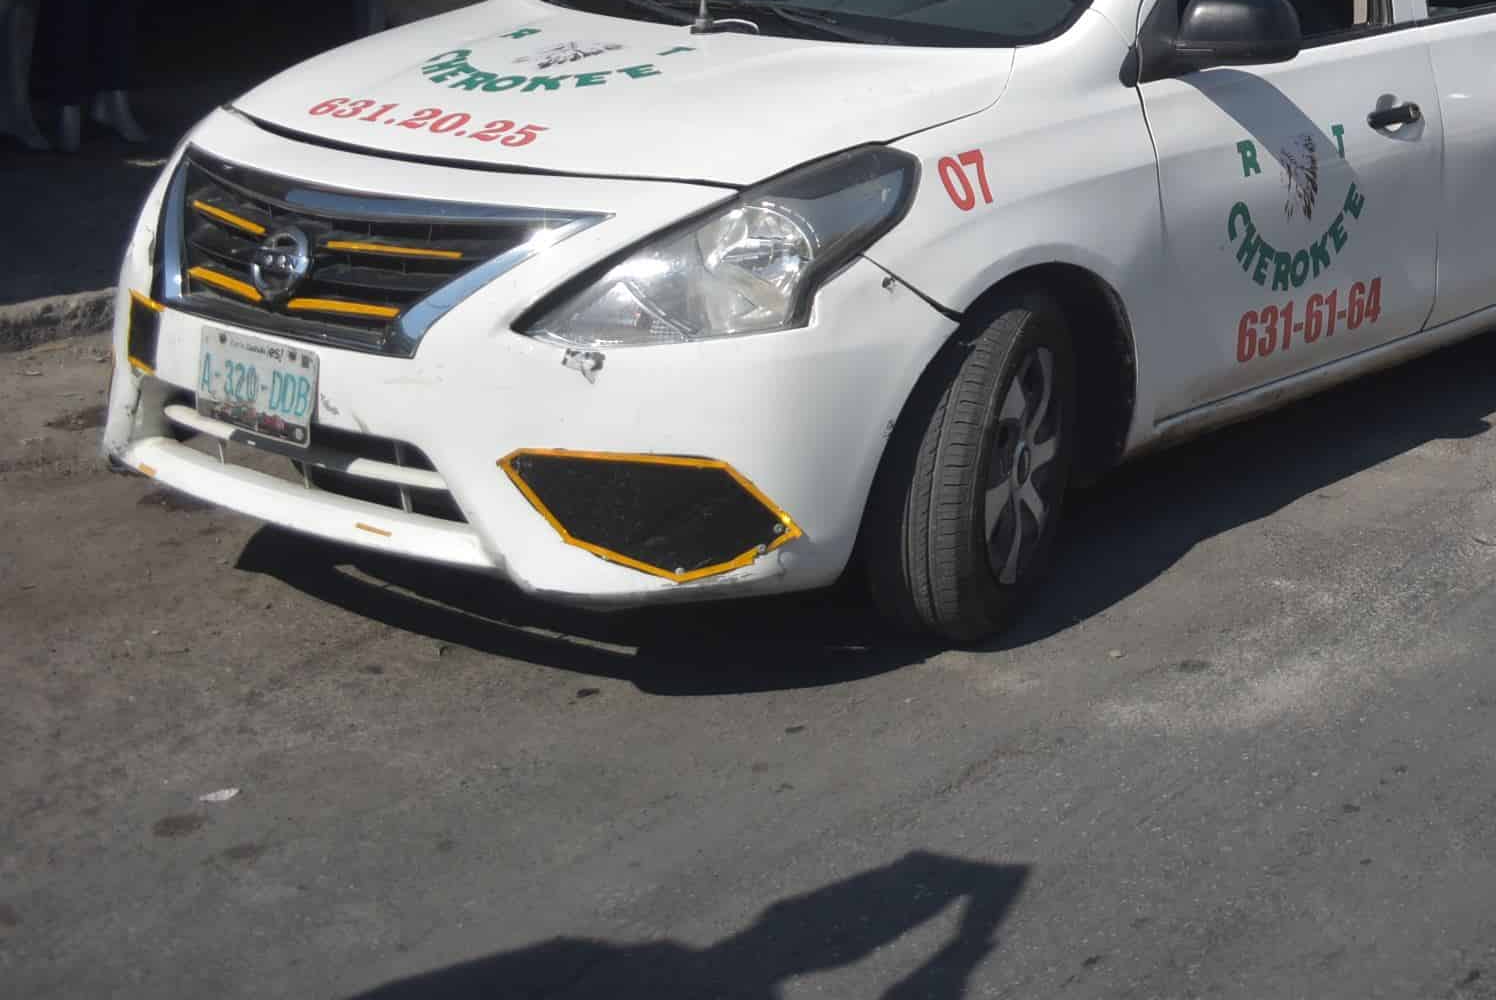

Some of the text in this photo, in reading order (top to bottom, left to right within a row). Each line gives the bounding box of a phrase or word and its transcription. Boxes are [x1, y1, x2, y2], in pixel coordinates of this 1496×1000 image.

[421, 48, 663, 93] CHEROKEE
[307, 96, 551, 148] 631.20.25
[937, 148, 993, 212] 07
[1236, 138, 1262, 177] R
[1227, 181, 1366, 292] CHEROKEE
[1236, 276, 1382, 364] 631-61-64
